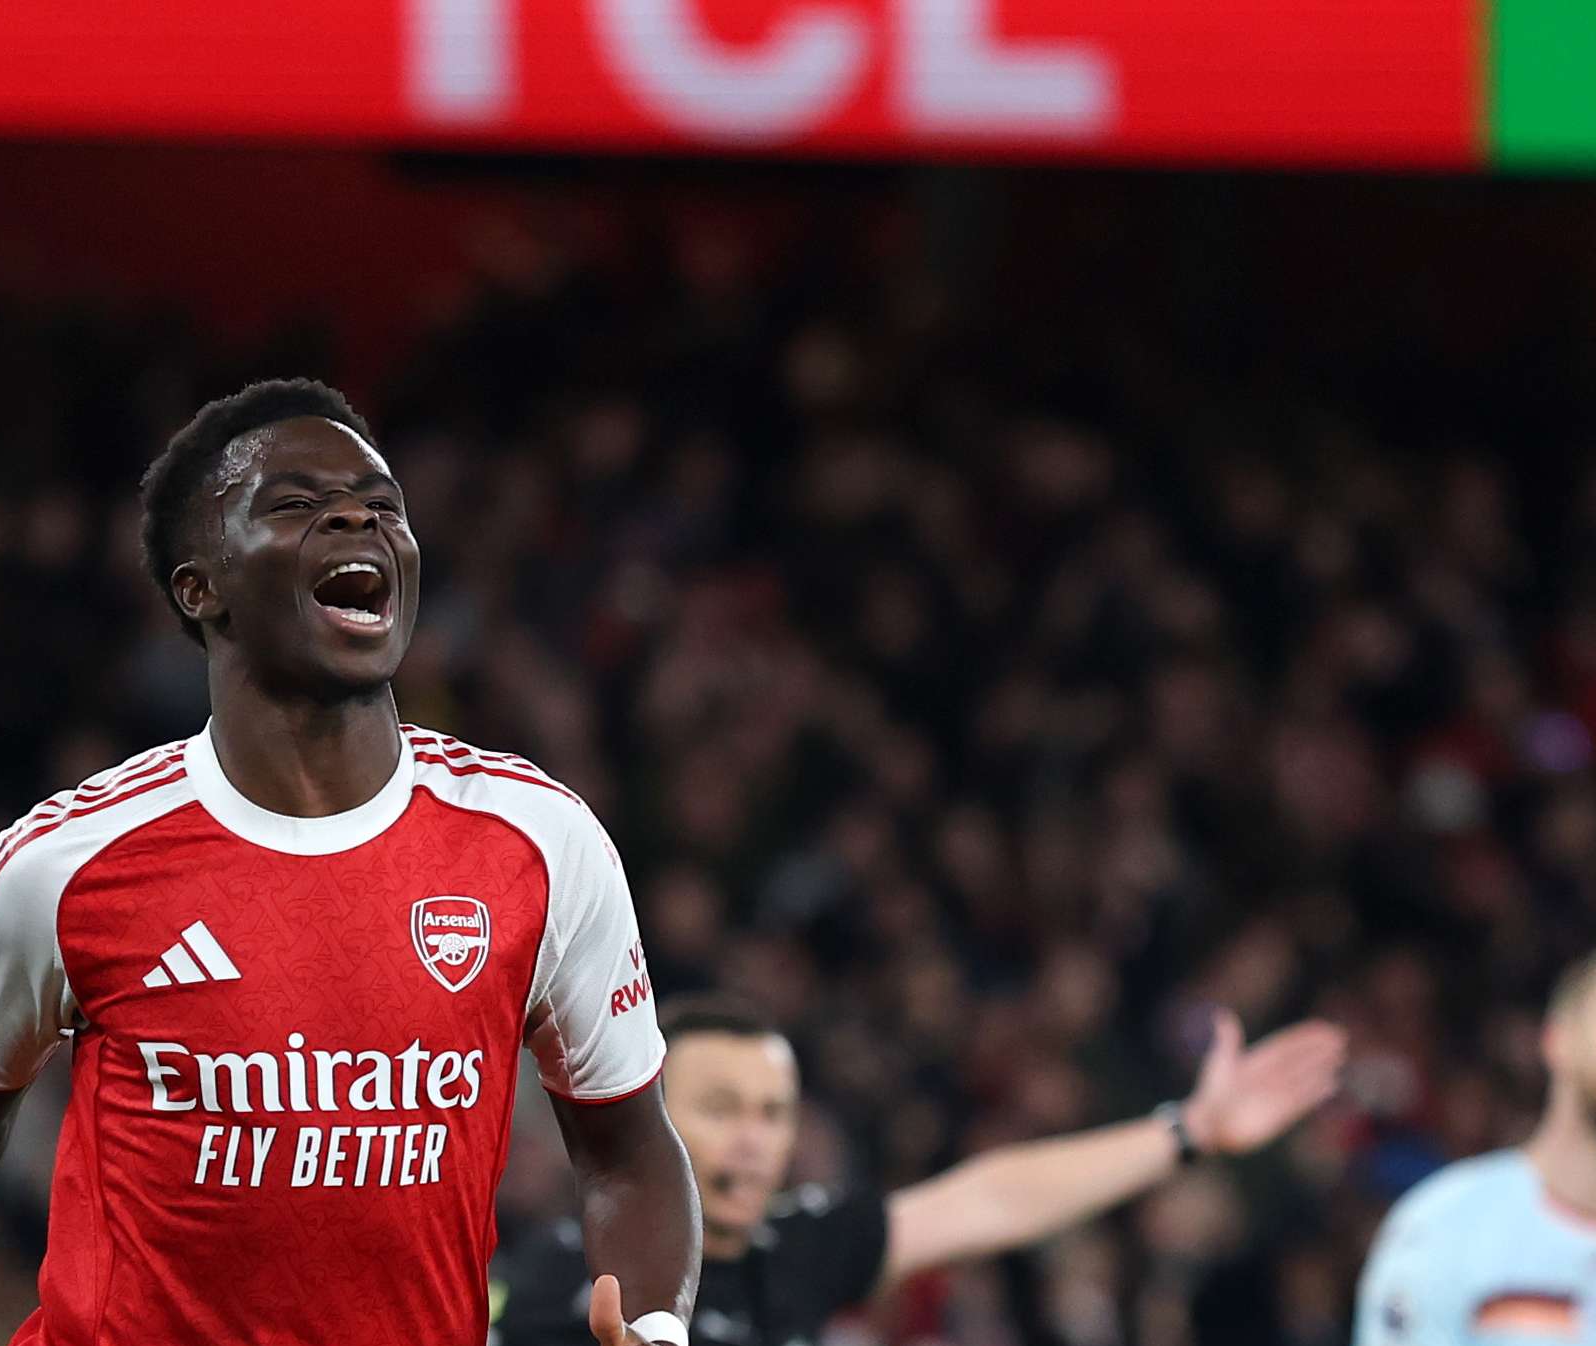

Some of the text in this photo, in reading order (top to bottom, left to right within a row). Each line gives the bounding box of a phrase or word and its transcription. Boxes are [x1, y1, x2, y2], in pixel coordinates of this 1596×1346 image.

[423, 911, 481, 928] Arsenal
[610, 974, 651, 1018] RW
[136, 1032, 484, 1113] Emirates
[194, 1123, 448, 1189] FLY BETTER
